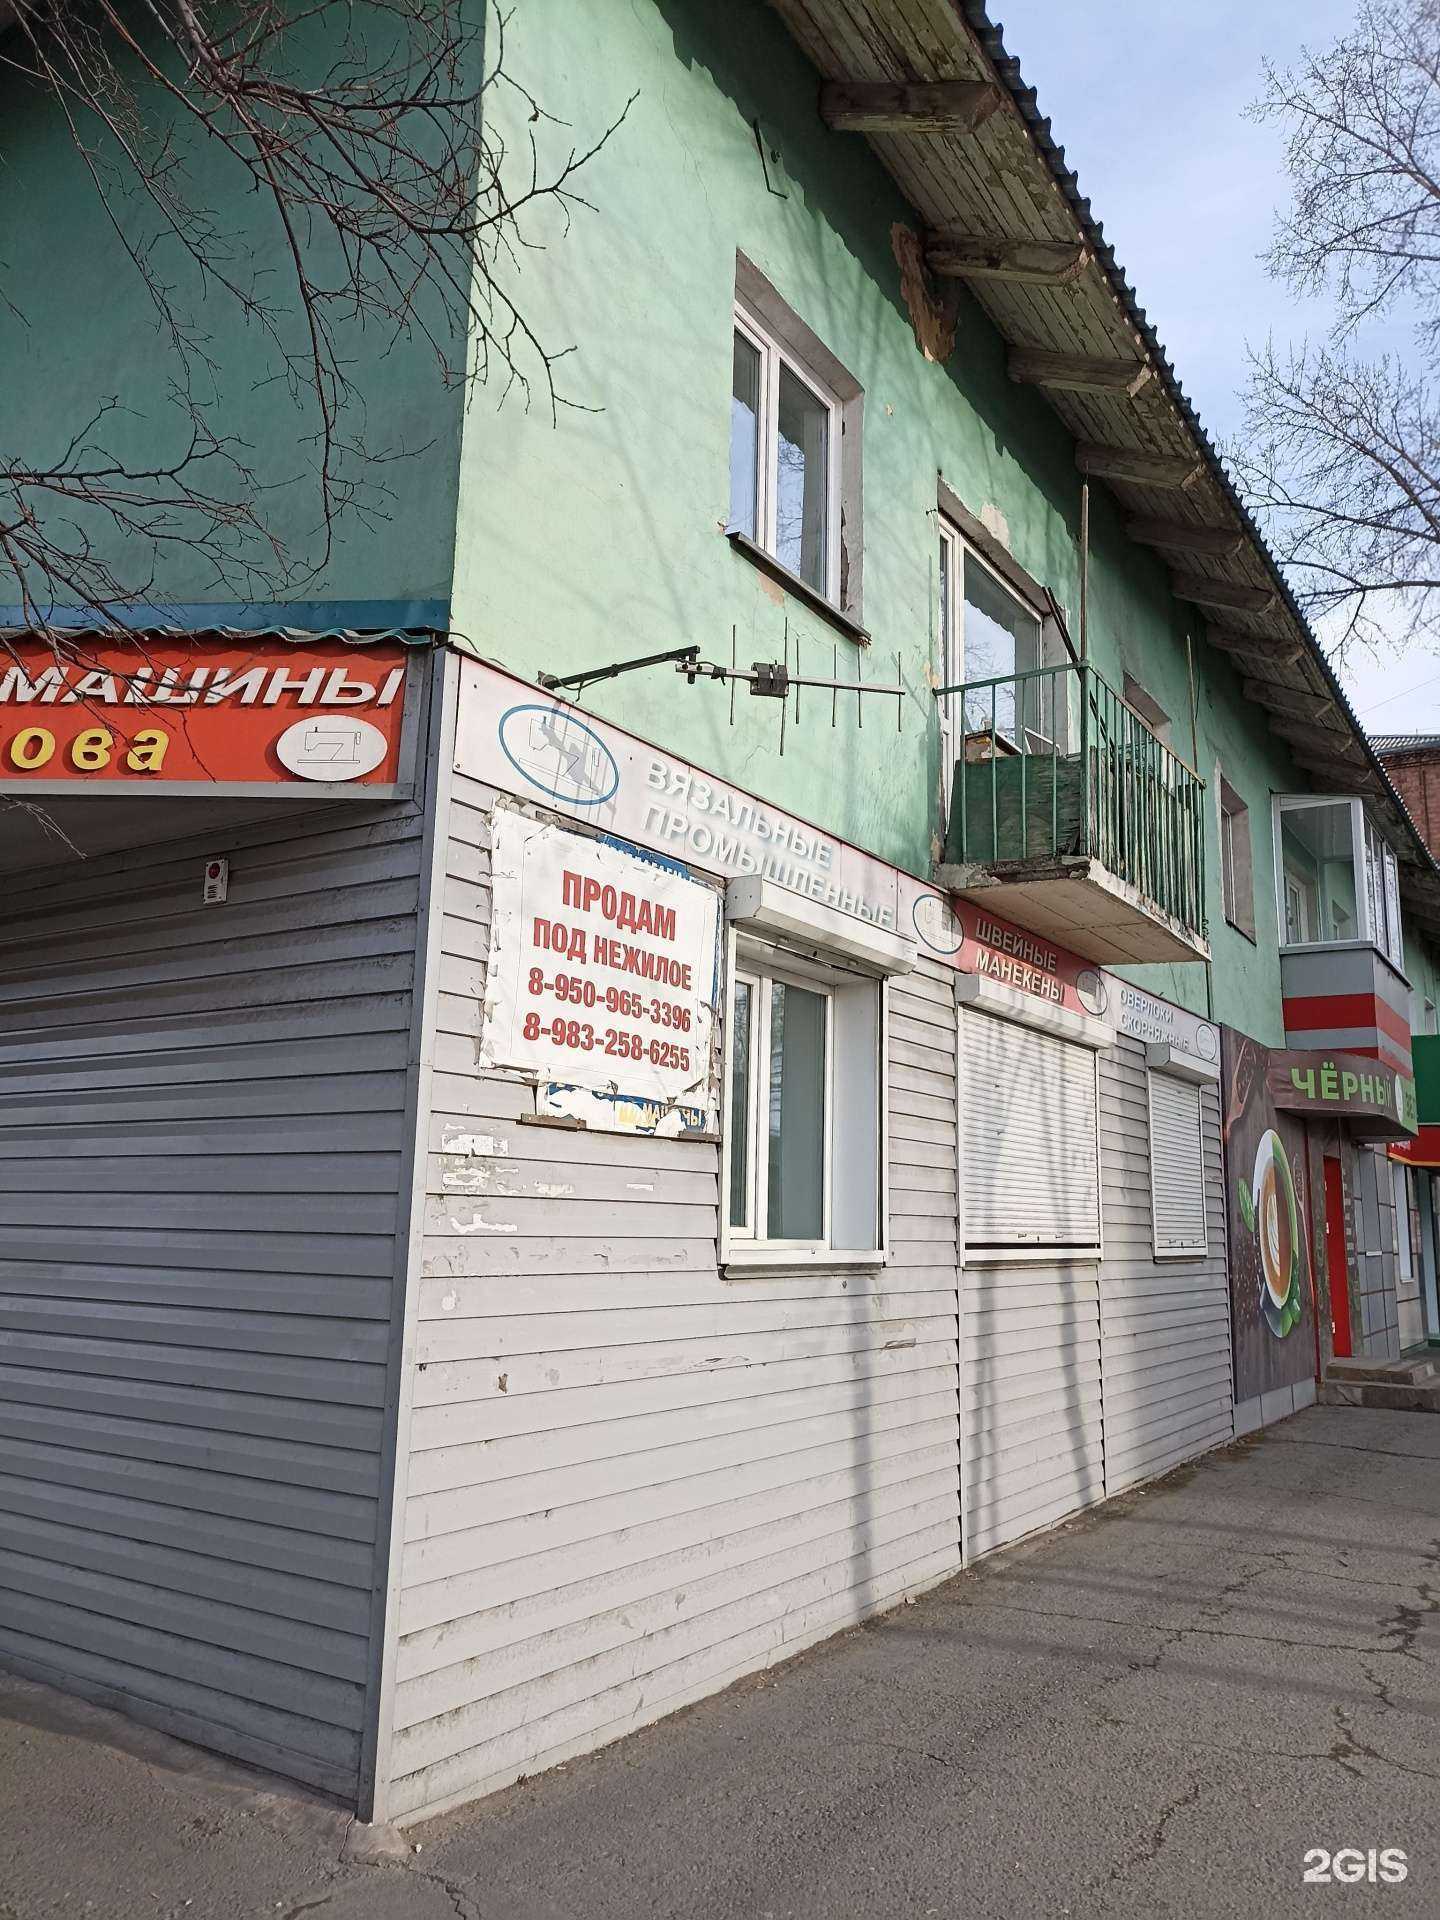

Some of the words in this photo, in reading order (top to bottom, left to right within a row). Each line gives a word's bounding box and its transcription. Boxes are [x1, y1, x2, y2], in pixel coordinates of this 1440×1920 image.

[0, 666, 405, 705] МАШИНЫ
[646, 758, 834, 868] ВЯЗАЛЬНЫЕ
[641, 806, 895, 927] ПРОМЫШЛЕННЫЕ
[562, 870, 677, 942] ПРОДАМ
[533, 917, 587, 964] ПОД
[593, 934, 692, 991] НЕЖИЛОЕ
[976, 918, 1057, 972] ШВЕЙНЫЕ
[527, 967, 691, 1033] 8-950-965-3396
[975, 947, 1065, 1003] МАНЕКЕНЫ
[1120, 988, 1174, 1024] ОВЕРЛОКИ
[1120, 1011, 1190, 1050] СКОРНЯЖНЫЕ
[523, 1012, 690, 1072] 8-983-258-6255
[1291, 1061, 1392, 1107] ЧЁРНЫЙ
